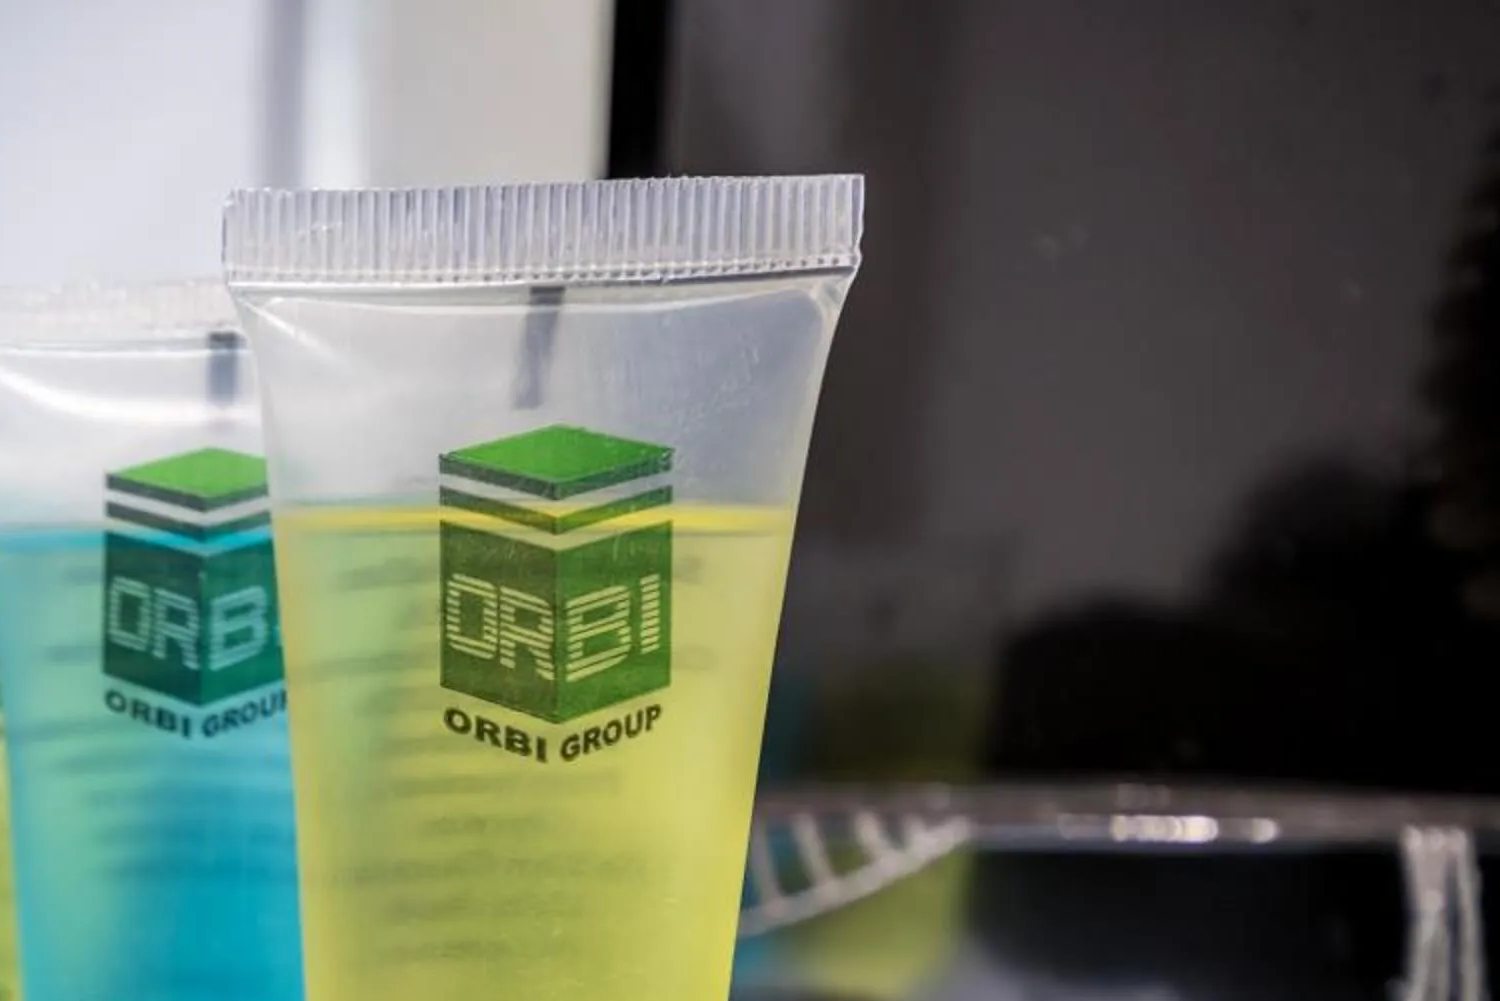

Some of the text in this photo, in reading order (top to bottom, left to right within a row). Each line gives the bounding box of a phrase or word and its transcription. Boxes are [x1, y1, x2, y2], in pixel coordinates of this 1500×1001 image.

[108, 576, 268, 671] ORB
[445, 573, 660, 683] ORBI
[104, 689, 193, 739] ORBI
[443, 704, 662, 763] ORBI GROUP
